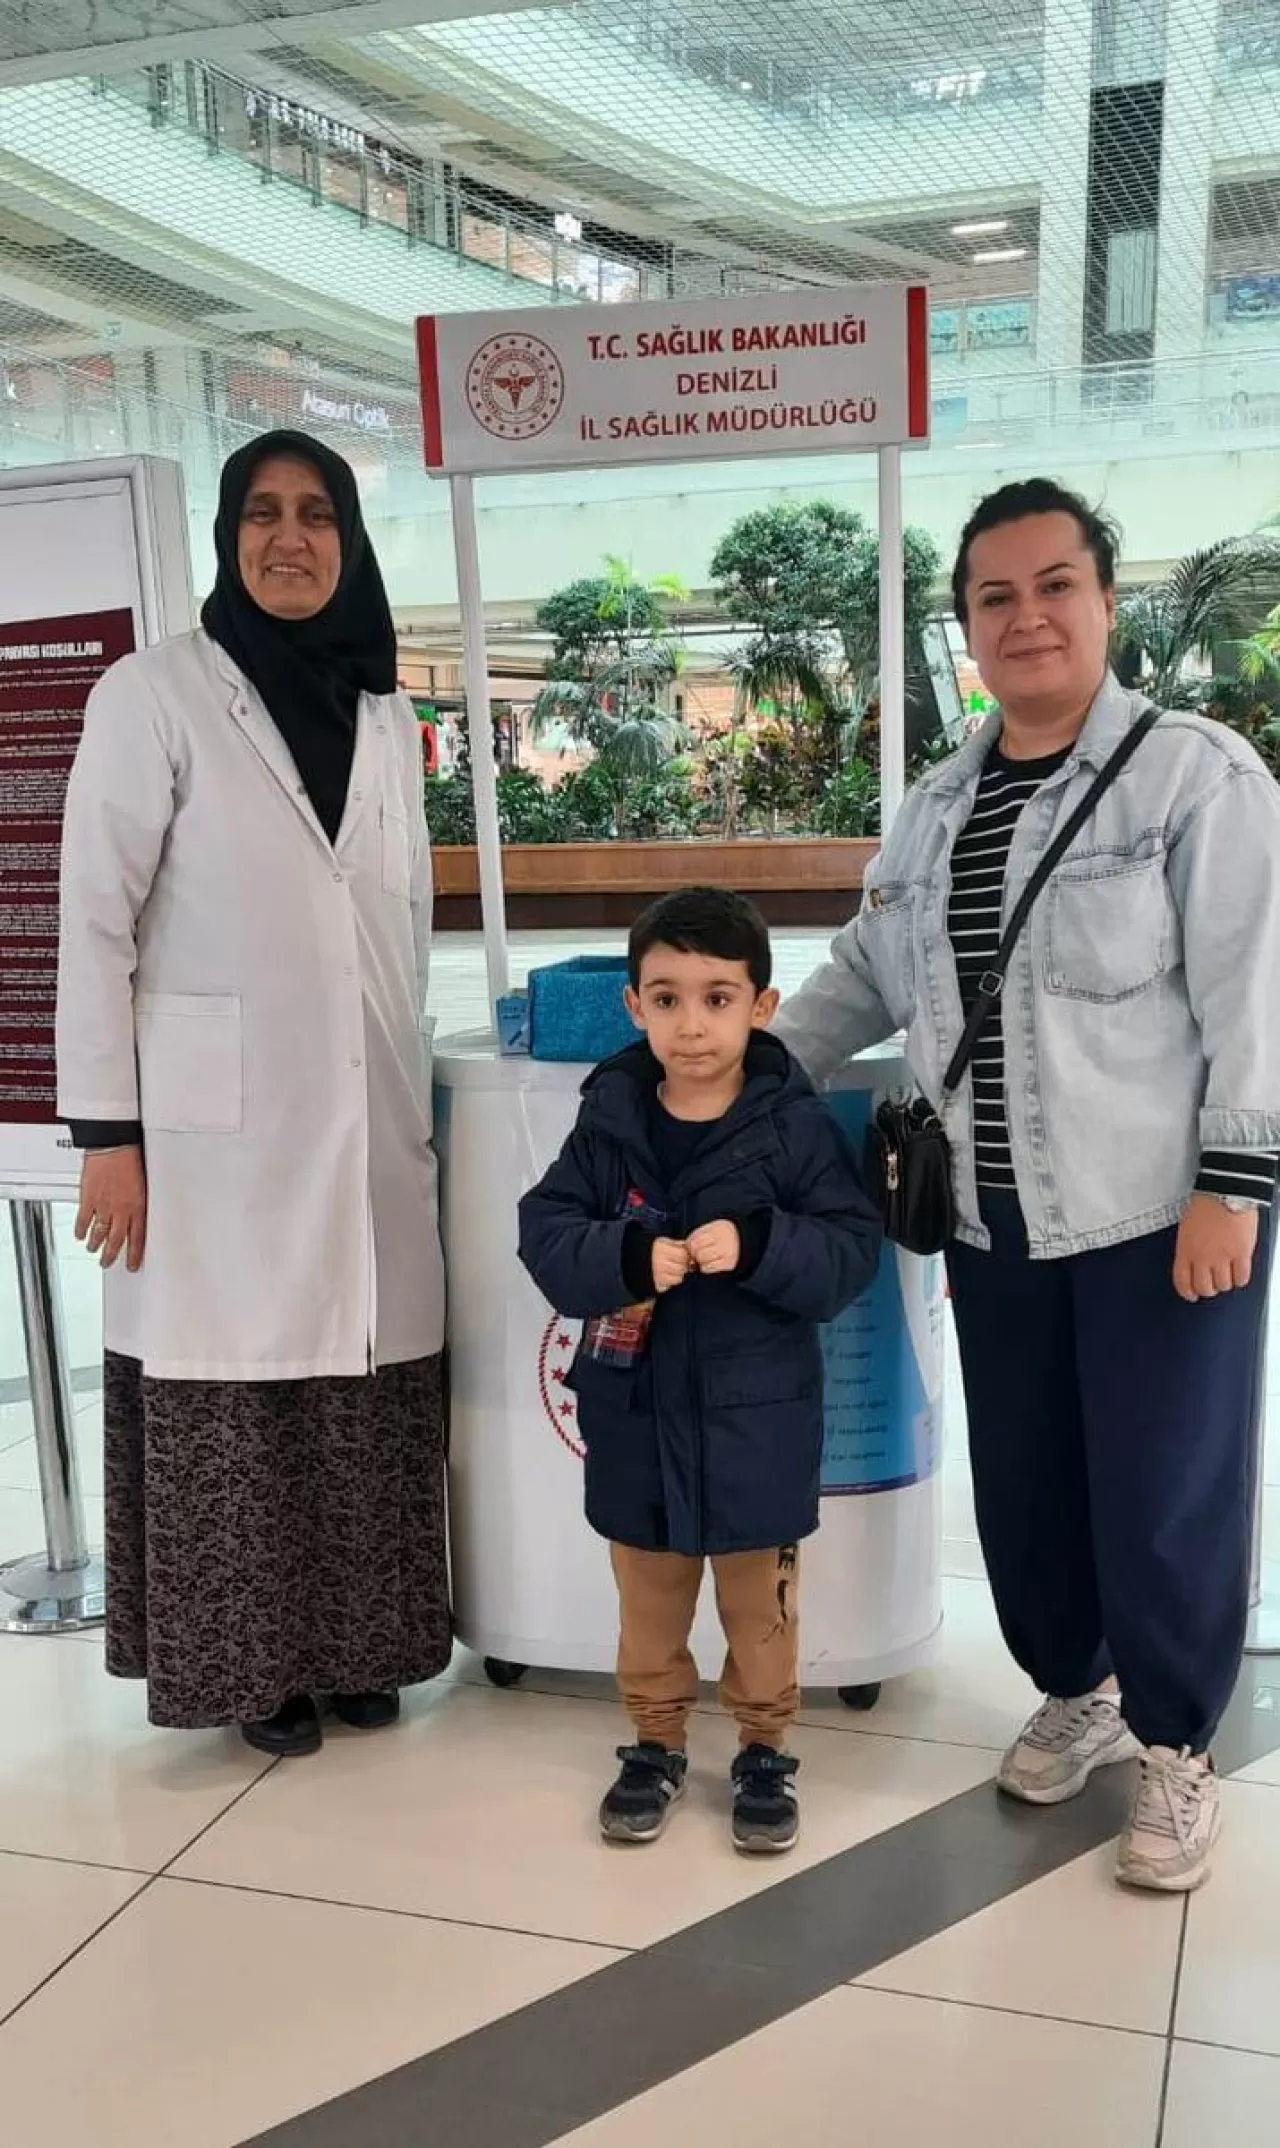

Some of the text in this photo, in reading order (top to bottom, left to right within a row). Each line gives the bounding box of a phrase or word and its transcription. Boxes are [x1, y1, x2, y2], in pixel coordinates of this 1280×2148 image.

[587, 314, 866, 361] T.C. SAĞLIK BAKANLIĞI
[676, 364, 778, 395] DENİZLİ
[581, 396, 877, 440] İL SAĞLIK MÜDÜRLÜĞÜ
